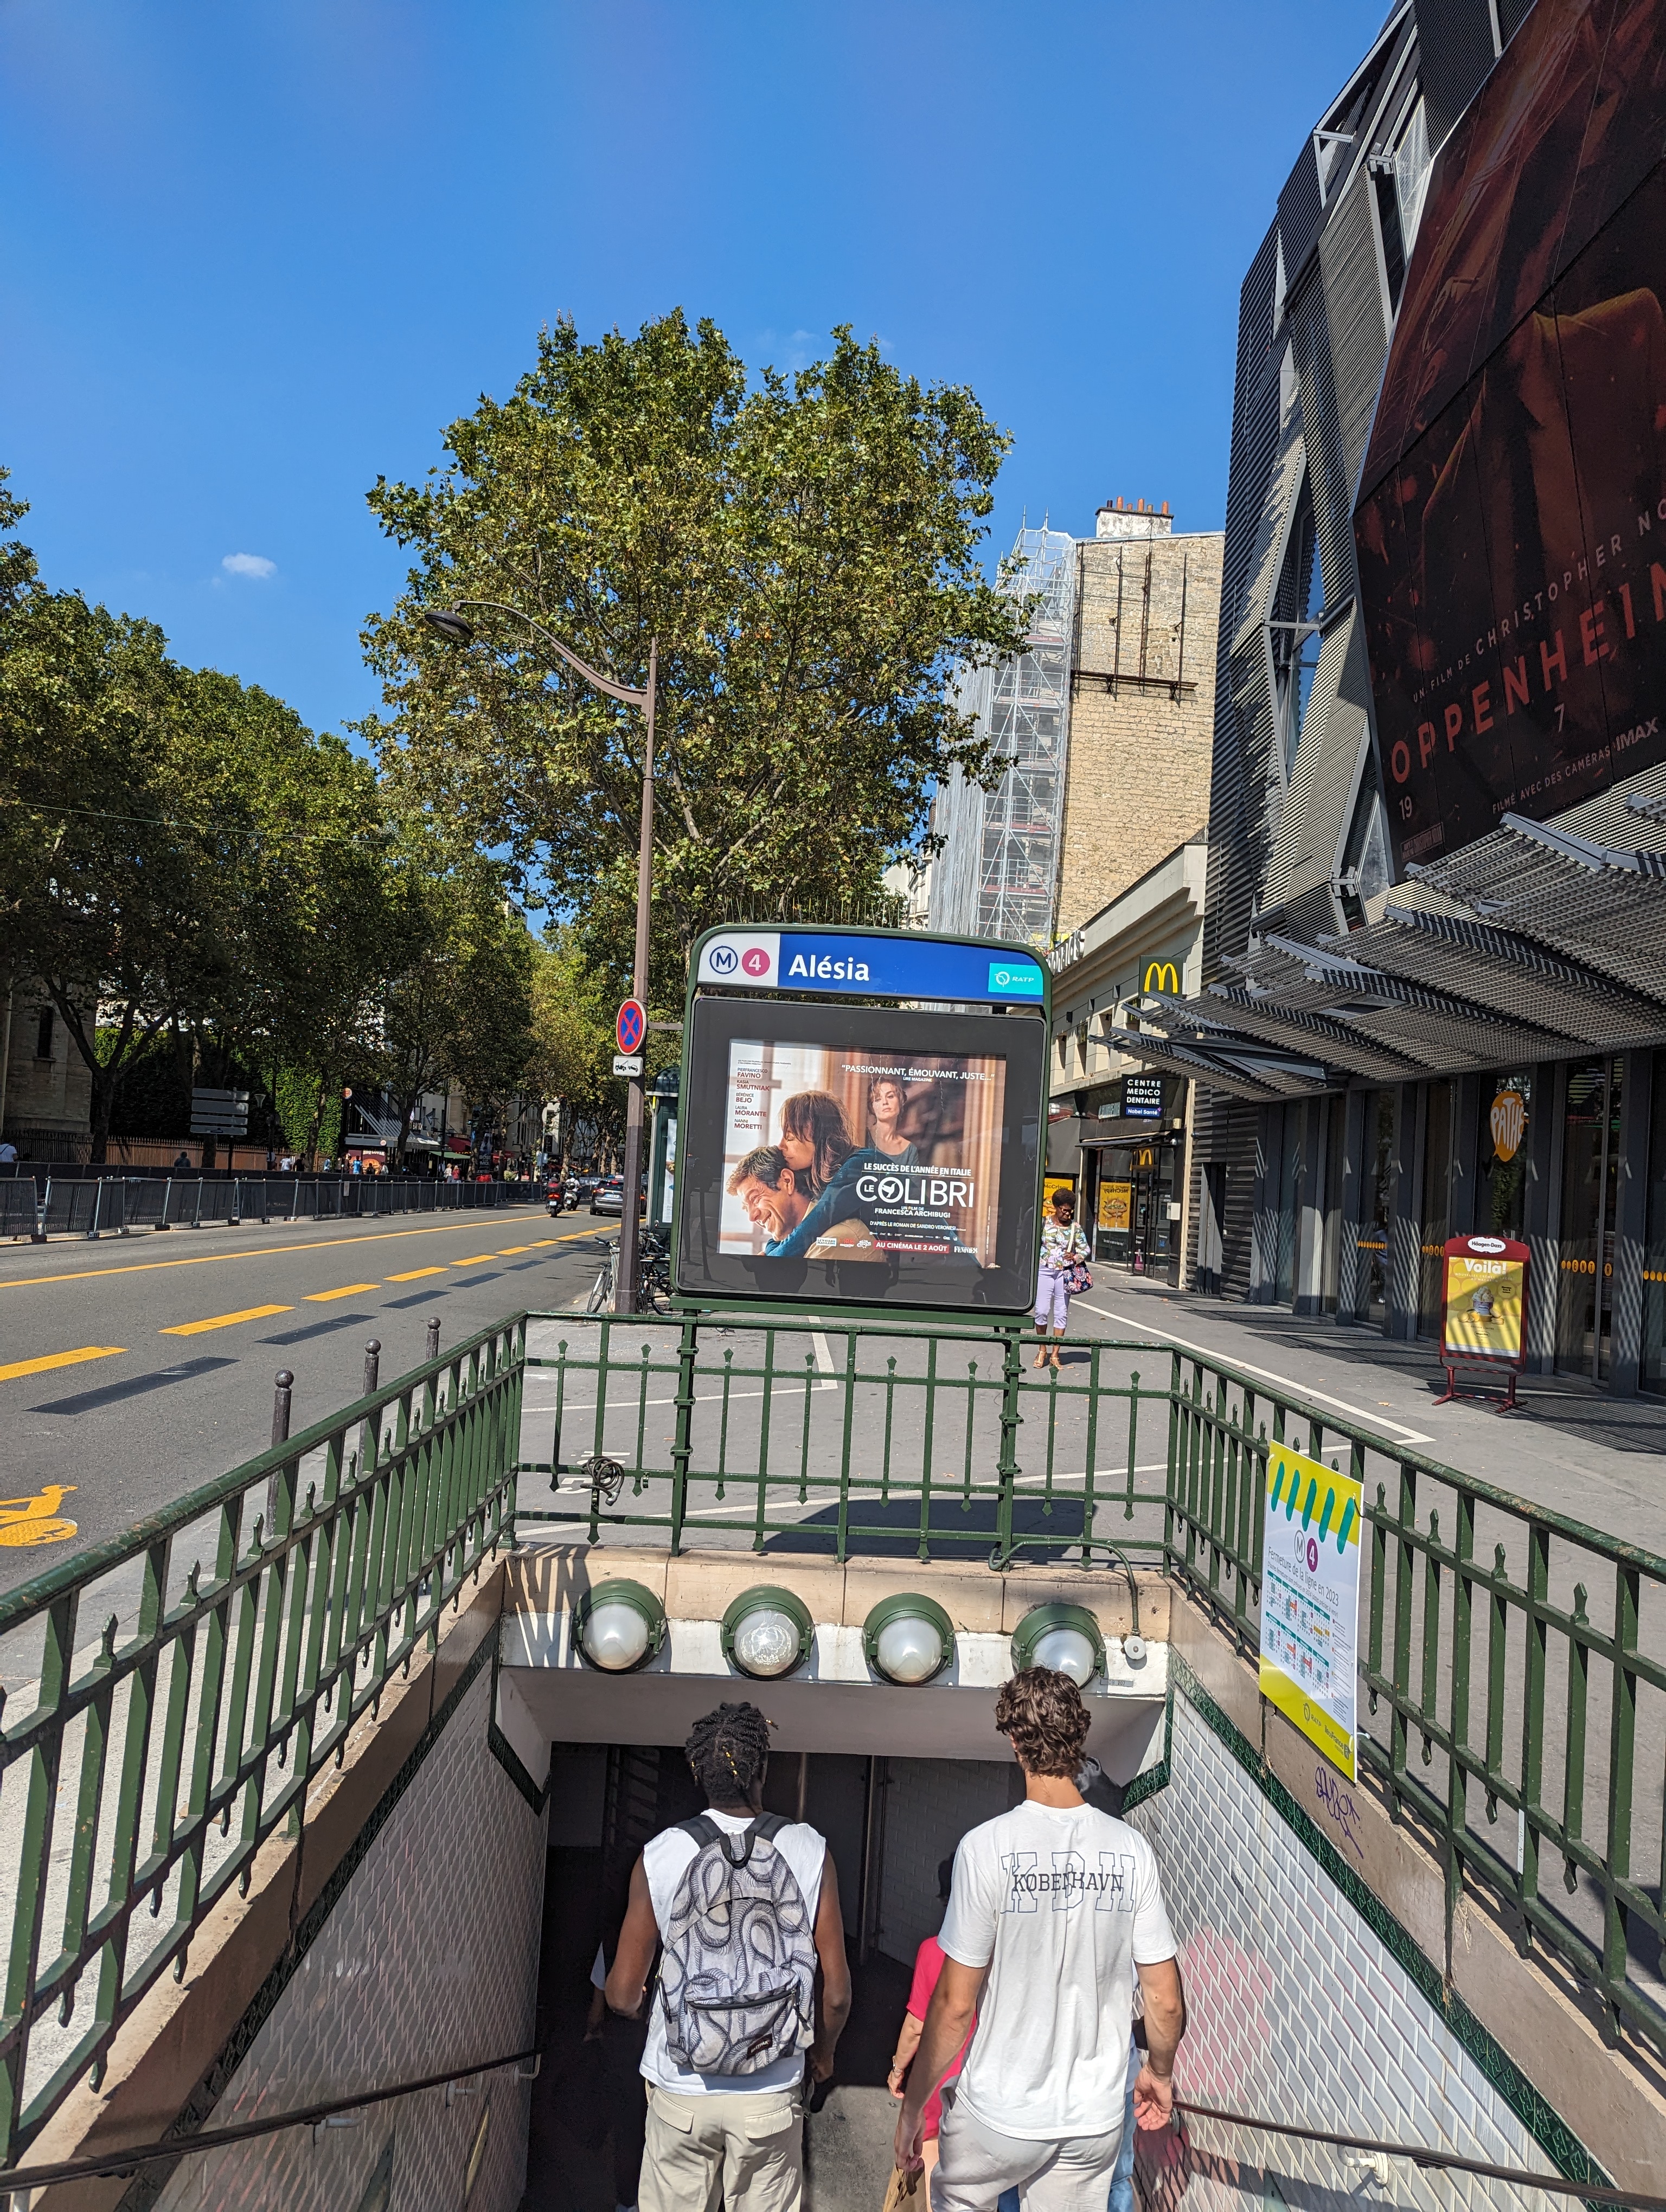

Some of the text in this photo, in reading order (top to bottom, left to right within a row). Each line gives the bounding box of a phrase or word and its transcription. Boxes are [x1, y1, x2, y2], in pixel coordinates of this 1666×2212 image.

[1413, 687, 1425, 703] UN
[1431, 667, 1452, 690] FILM
[1458, 653, 1470, 670] DE
[1476, 534, 1622, 655] CHRISTOPHER
[1492, 717, 1658, 814] FILMÉ AVEC DES CAMÉRAS IMAX
[1399, 796, 1412, 821] 19
[748, 954, 761, 971] 4
[788, 954, 869, 981] Alésia
[908, 1067, 958, 1080] ÉMOUVANT,
[1490, 1097, 1524, 1153] PATHÉ
[873, 1163, 899, 1172] SUCCÈS
[911, 1165, 939, 1174] L'ANNÉE
[856, 1175, 974, 1207] LE COLIBRI
[875, 1208, 950, 1218] FRANCESCA ARCHIBUGI
[1472, 1240, 1502, 1249] Häagen-Dazs
[1464, 1259, 1507, 1275] Voilà!
[1309, 1546, 1315, 1565] 4
[1268, 1546, 1339, 1606] Fermeture de la ligne en 2023
[1311, 1714, 1322, 1726] RATP
[1000, 1851, 1136, 1914] KBH
